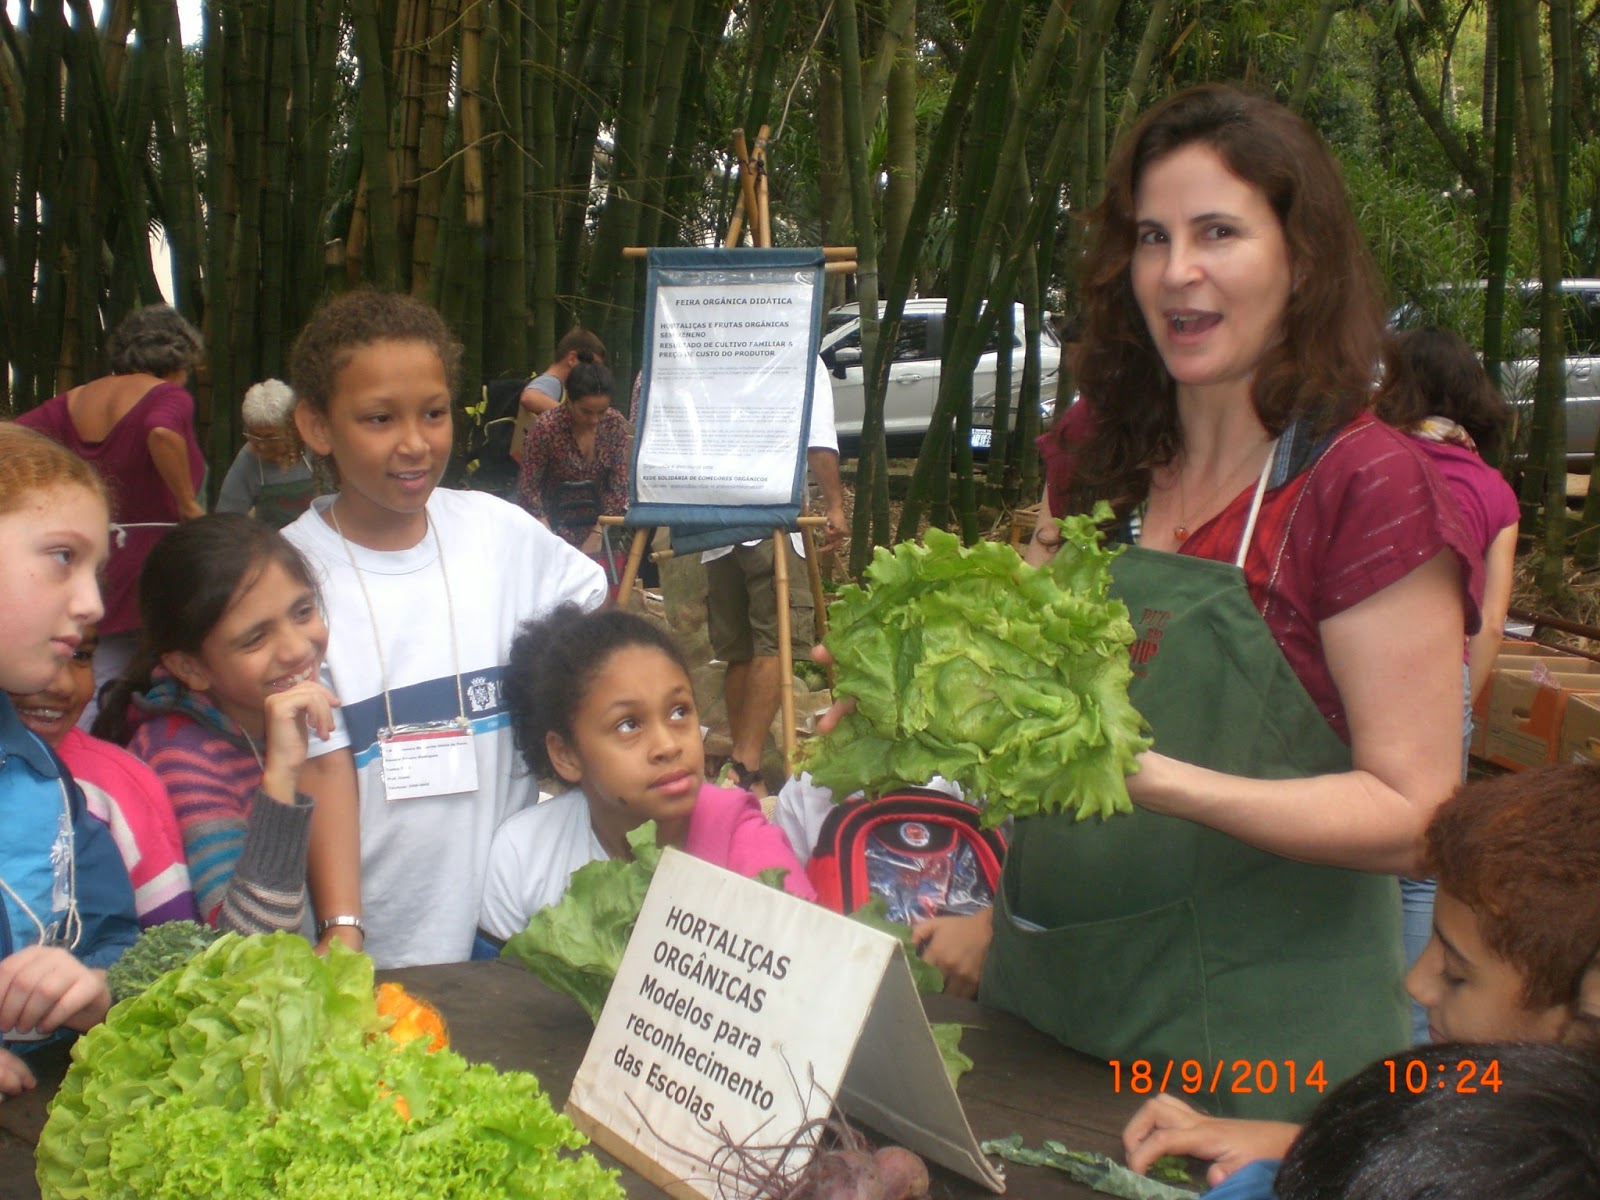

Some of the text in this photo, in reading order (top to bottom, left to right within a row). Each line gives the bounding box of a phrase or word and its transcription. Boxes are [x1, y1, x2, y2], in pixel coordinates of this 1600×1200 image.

[660, 322, 706, 330] HOTALIÇAS
[744, 320, 789, 328] ORGÂNICAS
[702, 297, 748, 306] ORGÂNICA
[750, 296, 792, 305] DIDÁTICA
[653, 941, 767, 1013] ORGÂNICAS
[665, 906, 791, 980] HORTALIÇAS
[638, 974, 761, 1058] Modelos para
[614, 1045, 715, 1122] das Escolas
[626, 1012, 774, 1111] reconhecimento
